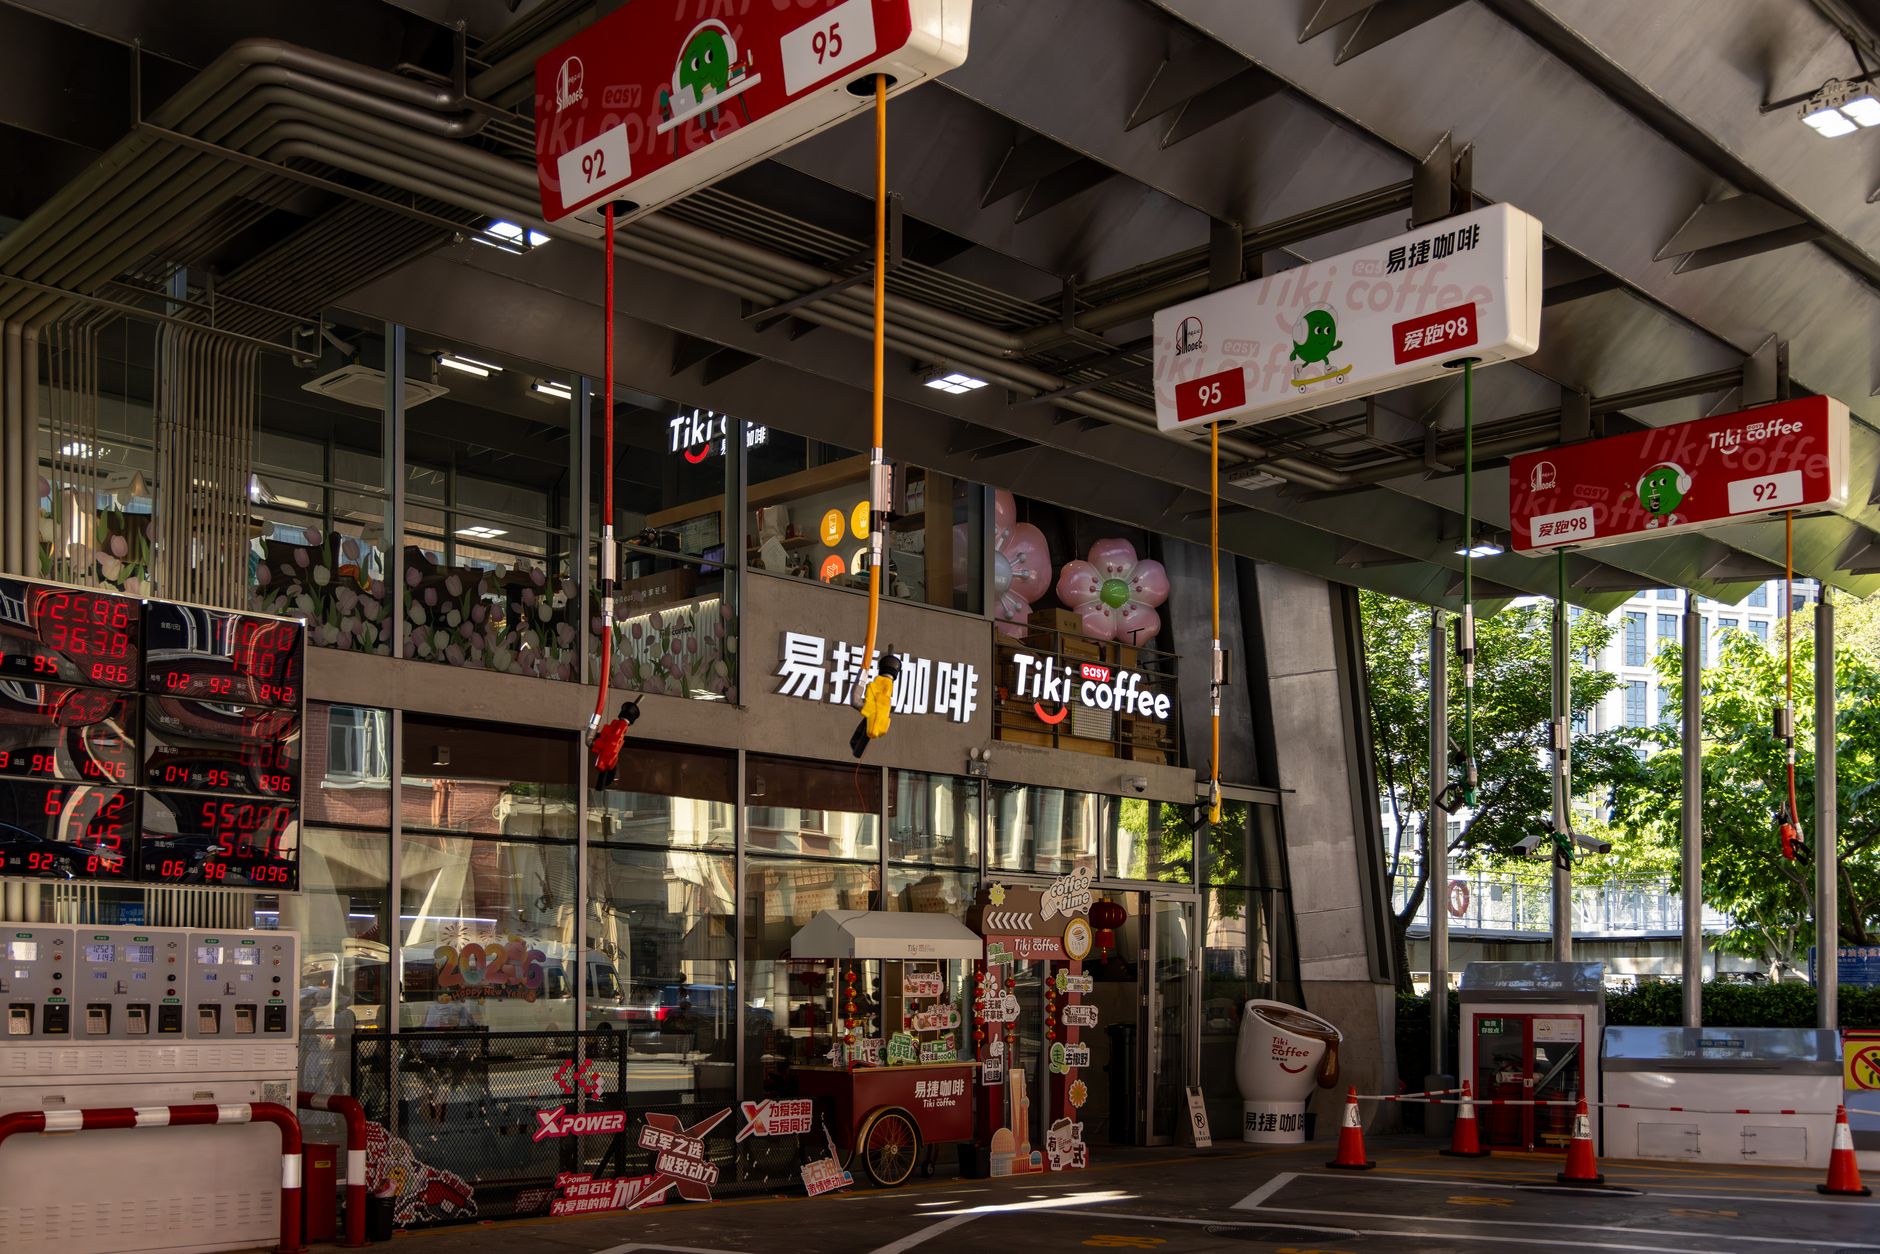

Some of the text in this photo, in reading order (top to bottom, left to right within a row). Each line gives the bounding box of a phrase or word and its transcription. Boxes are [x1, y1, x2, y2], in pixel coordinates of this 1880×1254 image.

[812, 22, 843, 65] 95
[605, 87, 641, 106] easy
[582, 149, 607, 184] 92
[1386, 223, 1480, 276] 易捷咖啡
[1257, 262, 1337, 307] Tiki
[1404, 317, 1469, 353] 爱跑98
[1224, 341, 1258, 356] easy
[1198, 382, 1222, 406] 95
[670, 409, 714, 452] Tiki
[1709, 418, 1804, 452] Tiki coffee
[1747, 422, 1765, 431] easy
[1576, 486, 1608, 499] easy
[1752, 483, 1778, 502] 92
[1538, 517, 1588, 538] 爱跑98
[34, 655, 58, 674] 95
[91, 663, 128, 683] 896
[1083, 666, 1109, 681] easy
[167, 671, 191, 689] 02
[209, 676, 231, 695] 92
[259, 684, 293, 702] 842
[1013, 653, 1171, 719] Tiki coffee
[32, 754, 57, 774] 98
[83, 759, 127, 779] 1096
[165, 766, 189, 783] 04
[207, 769, 230, 788] 95
[259, 774, 291, 792] 896
[28, 852, 54, 871] 92
[86, 855, 125, 874] 842
[161, 860, 185, 877] 06
[204, 862, 227, 879] 98
[251, 866, 289, 882] 1096
[1050, 875, 1089, 898] coffee
[1061, 891, 1090, 911] time
[1015, 938, 1031, 951] Tiki
[1033, 939, 1060, 951] coffee
[433, 943, 546, 988] 2026
[450, 988, 481, 1000] Happy
[483, 987, 500, 996] New
[1271, 1046, 1310, 1057] coffee
[1272, 1037, 1288, 1046] Tiki
[914, 1079, 965, 1098] 易捷咖啡
[768, 1101, 811, 1118] 为爱奔跑
[923, 1097, 957, 1108] Tiki coffee
[533, 1106, 626, 1140] XPOWER
[768, 1118, 811, 1134] 与爱同行
[642, 1129, 703, 1159] 冠军之选
[659, 1153, 719, 1184] 极致动力
[808, 1158, 837, 1182] 石油
[558, 1175, 591, 1186] XPOWER
[567, 1181, 612, 1197] 中国石化
[553, 1197, 611, 1214] 为爱跑的你
